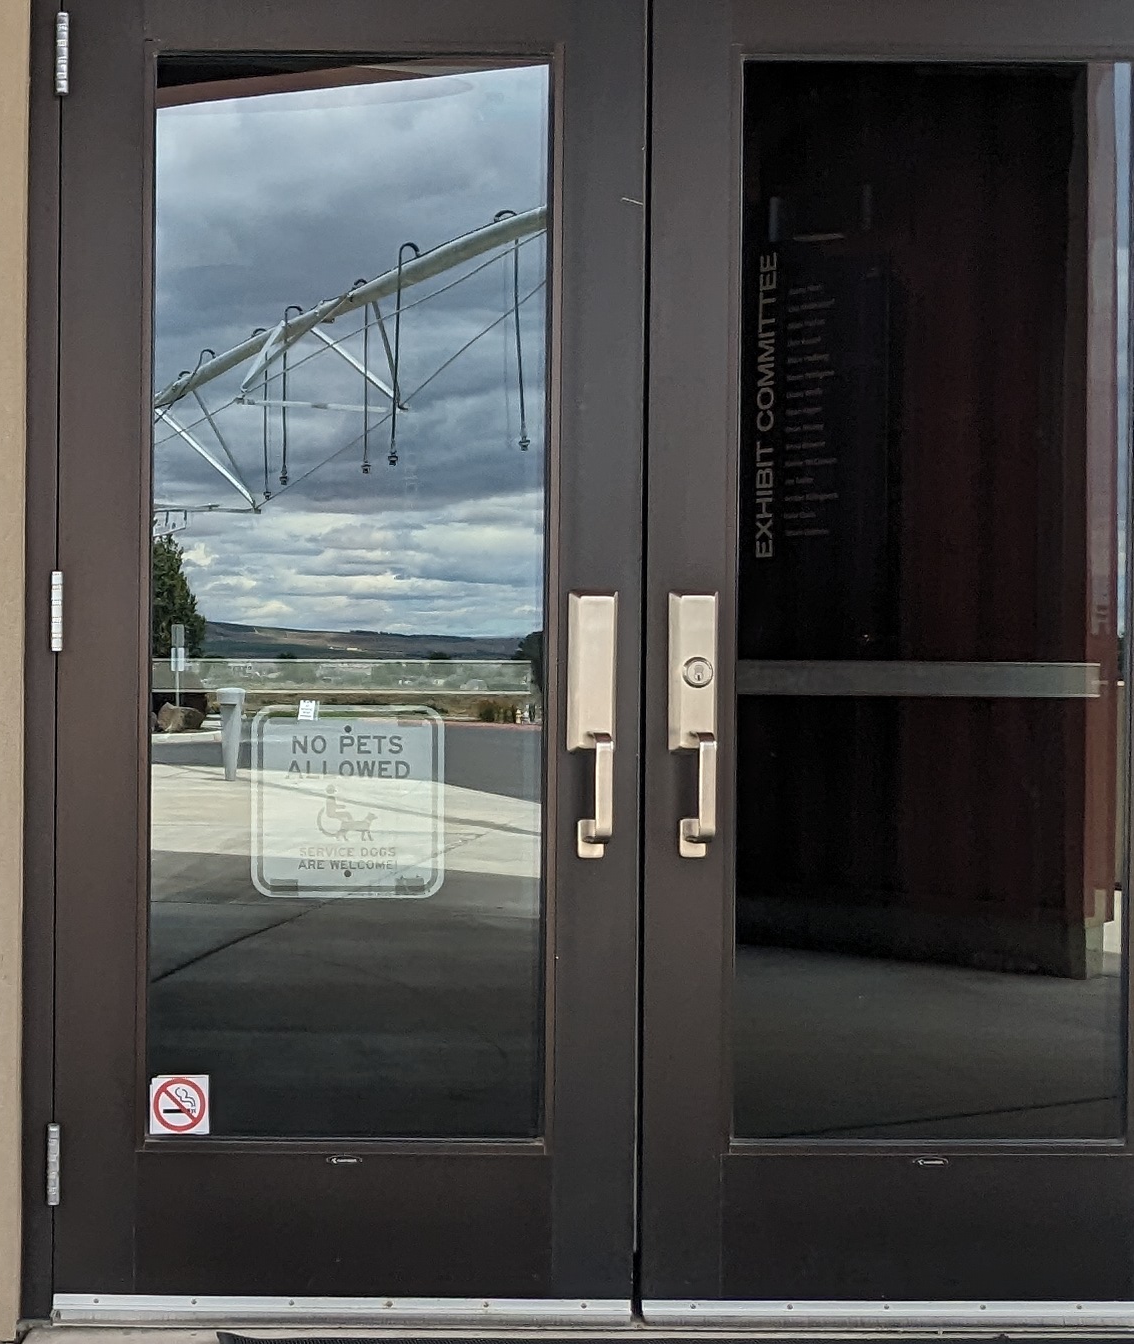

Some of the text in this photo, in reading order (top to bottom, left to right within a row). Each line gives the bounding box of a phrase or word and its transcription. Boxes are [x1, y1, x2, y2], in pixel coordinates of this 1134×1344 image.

[756, 251, 777, 558] EXHIBIT COMMITTEE
[292, 735, 404, 754] NO PETS
[286, 760, 411, 779] ALLOWED
[299, 847, 397, 857] SERVICE DOGS
[298, 859, 328, 870] ARE
